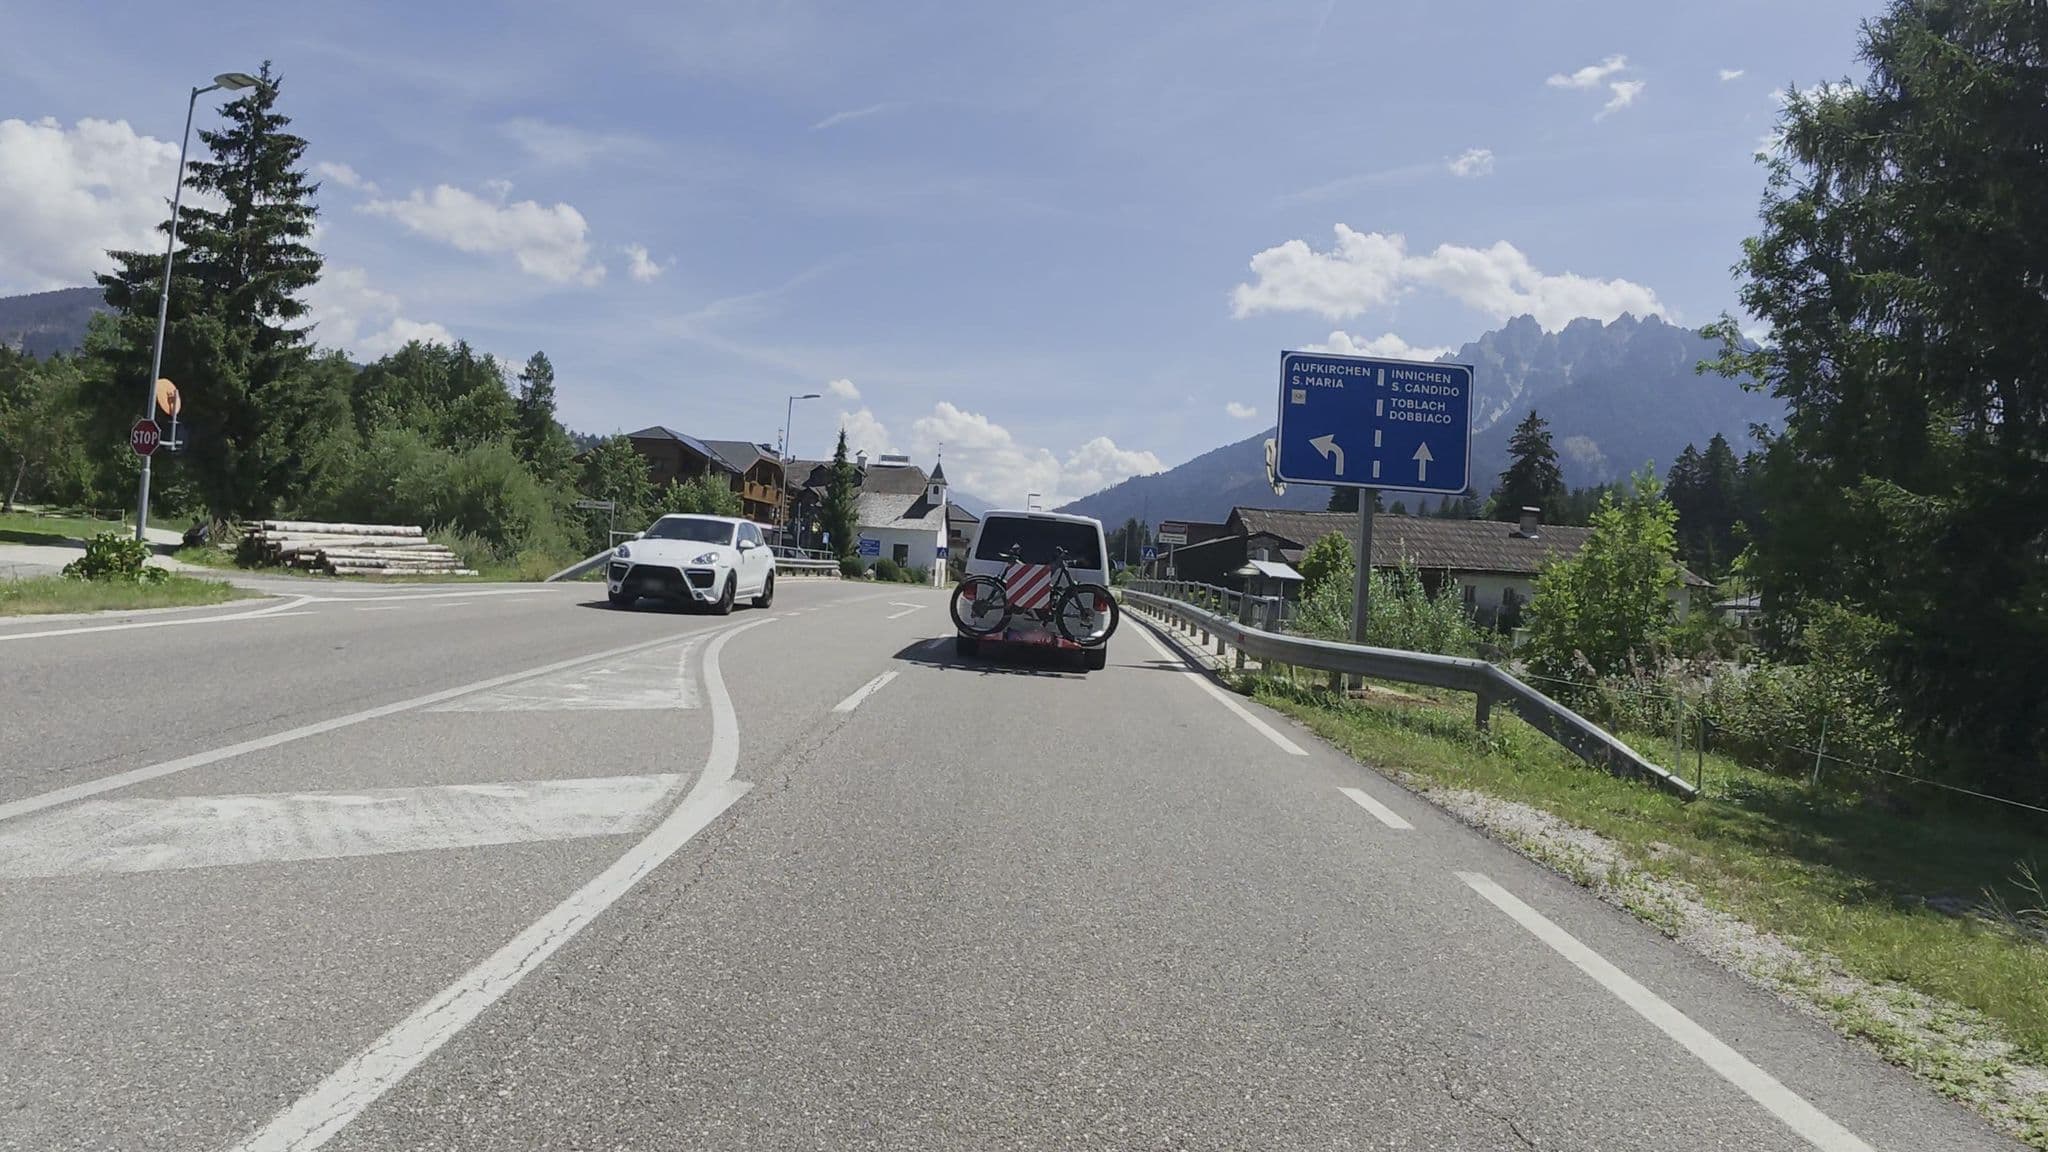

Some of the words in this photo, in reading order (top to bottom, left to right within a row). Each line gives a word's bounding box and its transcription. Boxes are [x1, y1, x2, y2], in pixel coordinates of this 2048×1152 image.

[1292, 362, 1371, 377] AUFKIRCHEN
[1391, 369, 1452, 384] INNICHEN
[1292, 375, 1303, 386] S.
[1305, 376, 1344, 389] MARIA
[1391, 382, 1403, 393] S.
[1404, 383, 1460, 397] CANDIDO
[1390, 397, 1446, 412] TOBLACH
[1389, 411, 1452, 425] DOBBIACO
[133, 430, 158, 445] STOP
